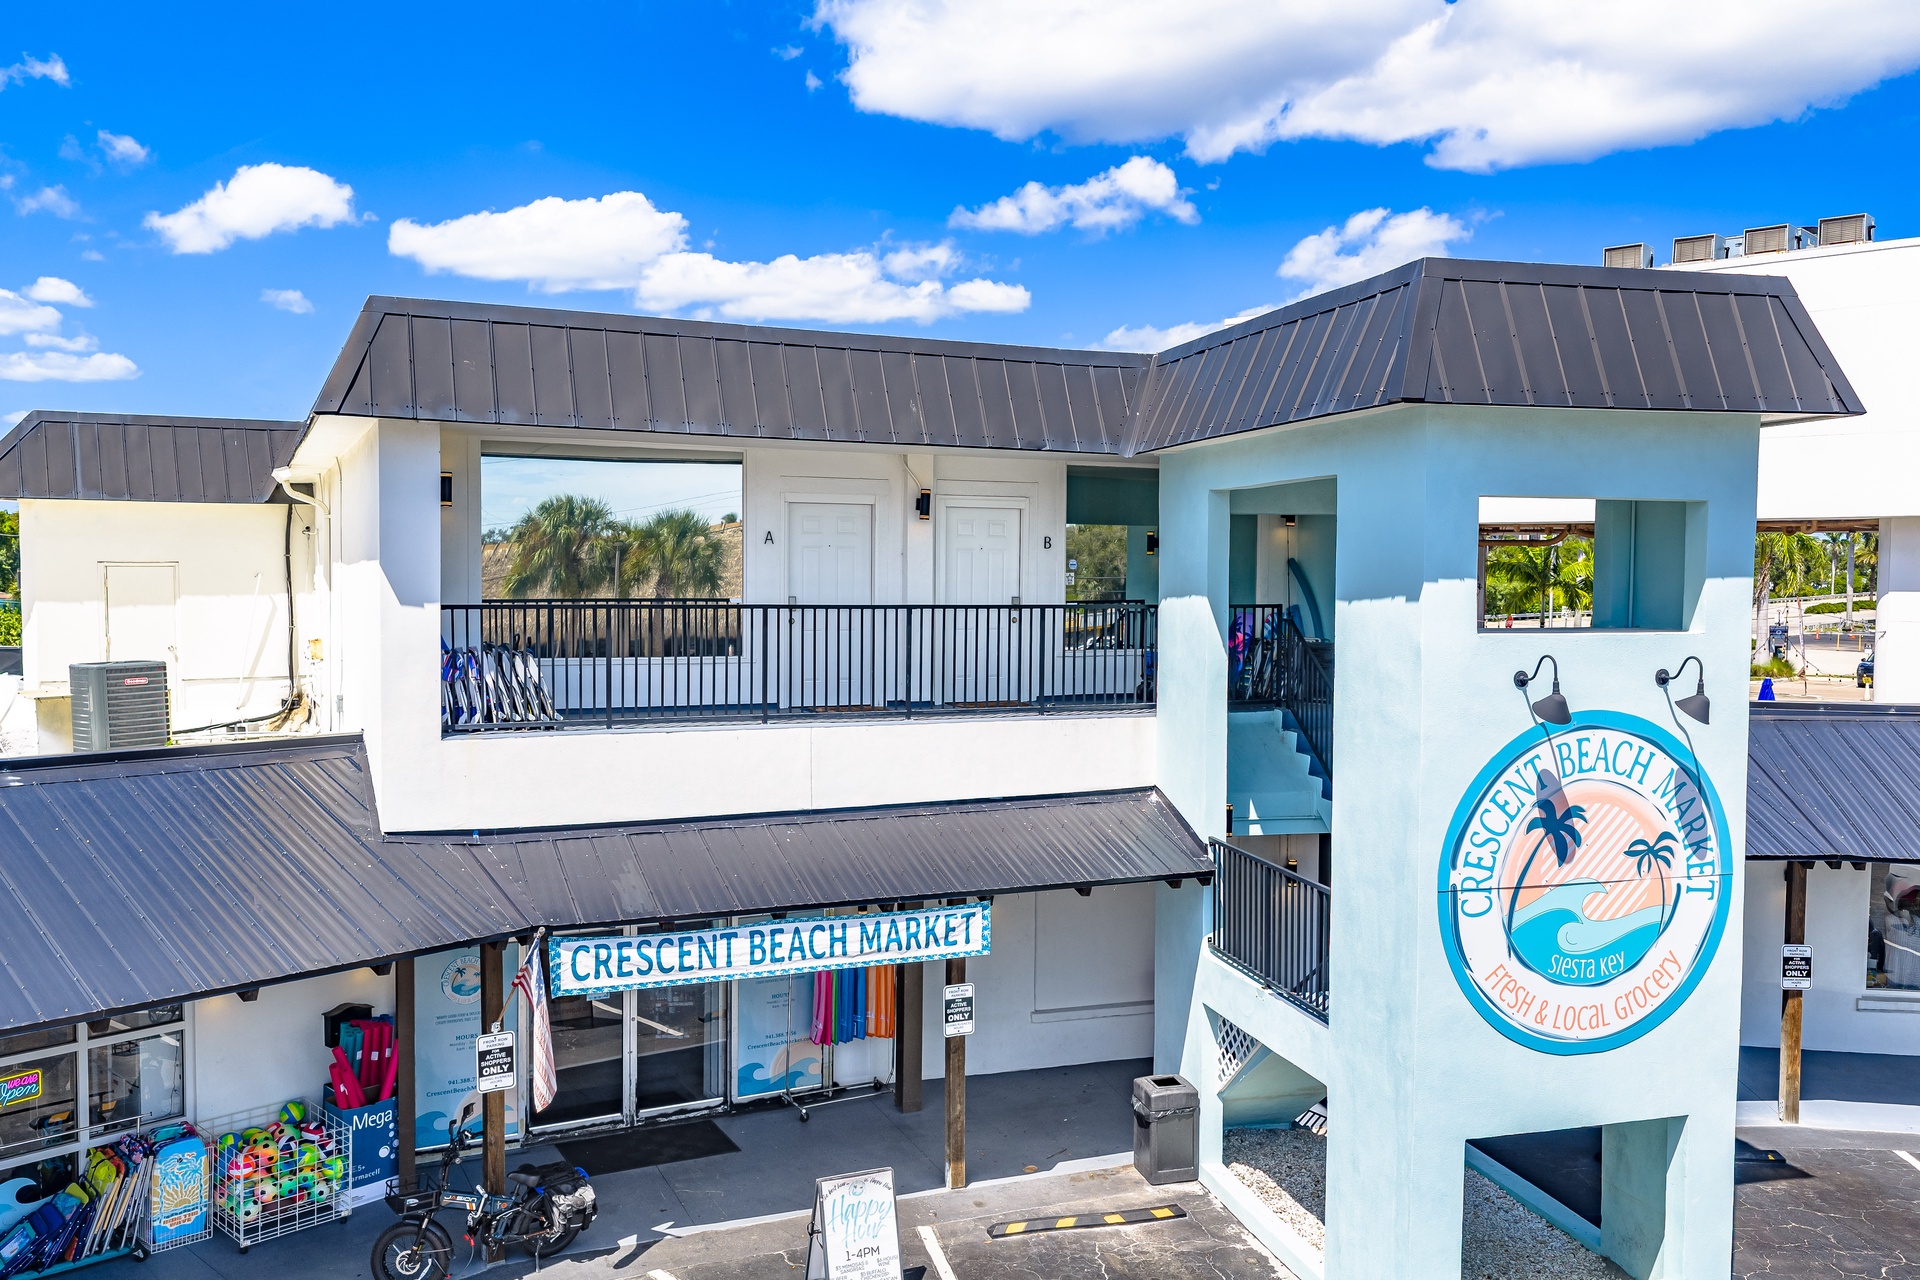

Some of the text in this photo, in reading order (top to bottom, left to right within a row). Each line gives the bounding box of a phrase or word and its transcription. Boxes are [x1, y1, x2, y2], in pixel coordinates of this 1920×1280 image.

[764, 530, 774, 545] A
[1043, 536, 1052, 550] B
[1460, 736, 1716, 918] CRESCENT BEACH MARKET
[571, 911, 976, 982] CRESCENT BEACH MARKET
[460, 957, 479, 965] BEACH
[946, 1006, 972, 1014] SHOPPERS
[948, 1012, 970, 1022] ONLY
[1534, 1000, 1548, 1026] &
[455, 1033, 479, 1041] HOURS
[765, 1030, 797, 1039] 941.388.756
[480, 1057, 511, 1067] SHOPPERS
[485, 1051, 507, 1060] ACTIVE
[482, 1064, 510, 1076] ONLY
[7, 1073, 39, 1089] we are
[352, 1109, 393, 1131] Mega
[827, 1194, 893, 1233] Happy
[841, 1218, 887, 1249] Hour
[845, 1245, 880, 1262] 1-4PM
[842, 1261, 864, 1269] MIMOSAS
